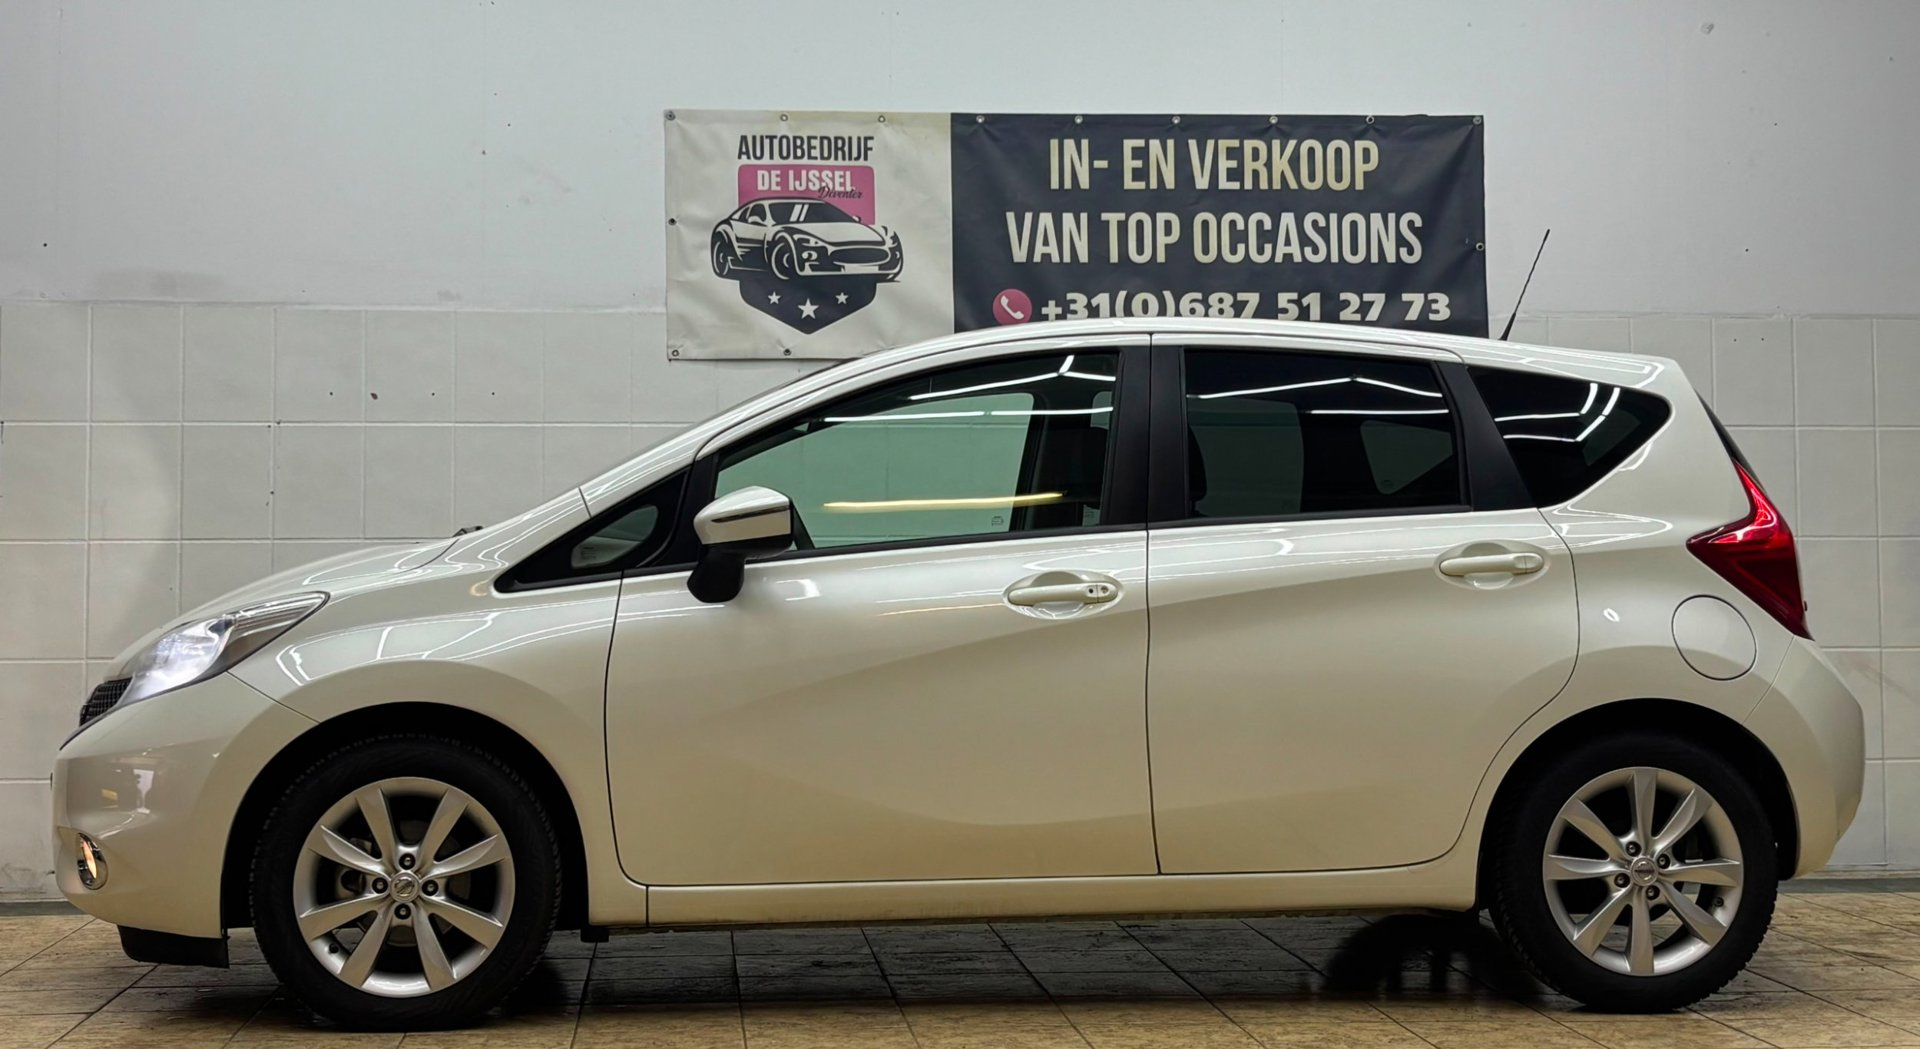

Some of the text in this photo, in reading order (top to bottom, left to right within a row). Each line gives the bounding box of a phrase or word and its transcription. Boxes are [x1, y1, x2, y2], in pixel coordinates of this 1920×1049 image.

[737, 135, 875, 161] AUTOBEDRIJF
[1049, 138, 1379, 191] IN- EN VERKOOP
[757, 169, 855, 192] DE IJSSEL
[1006, 212, 1423, 264] VAN TOP OCCASIONS
[1041, 290, 1451, 321] +31(0)687 51 27 73
